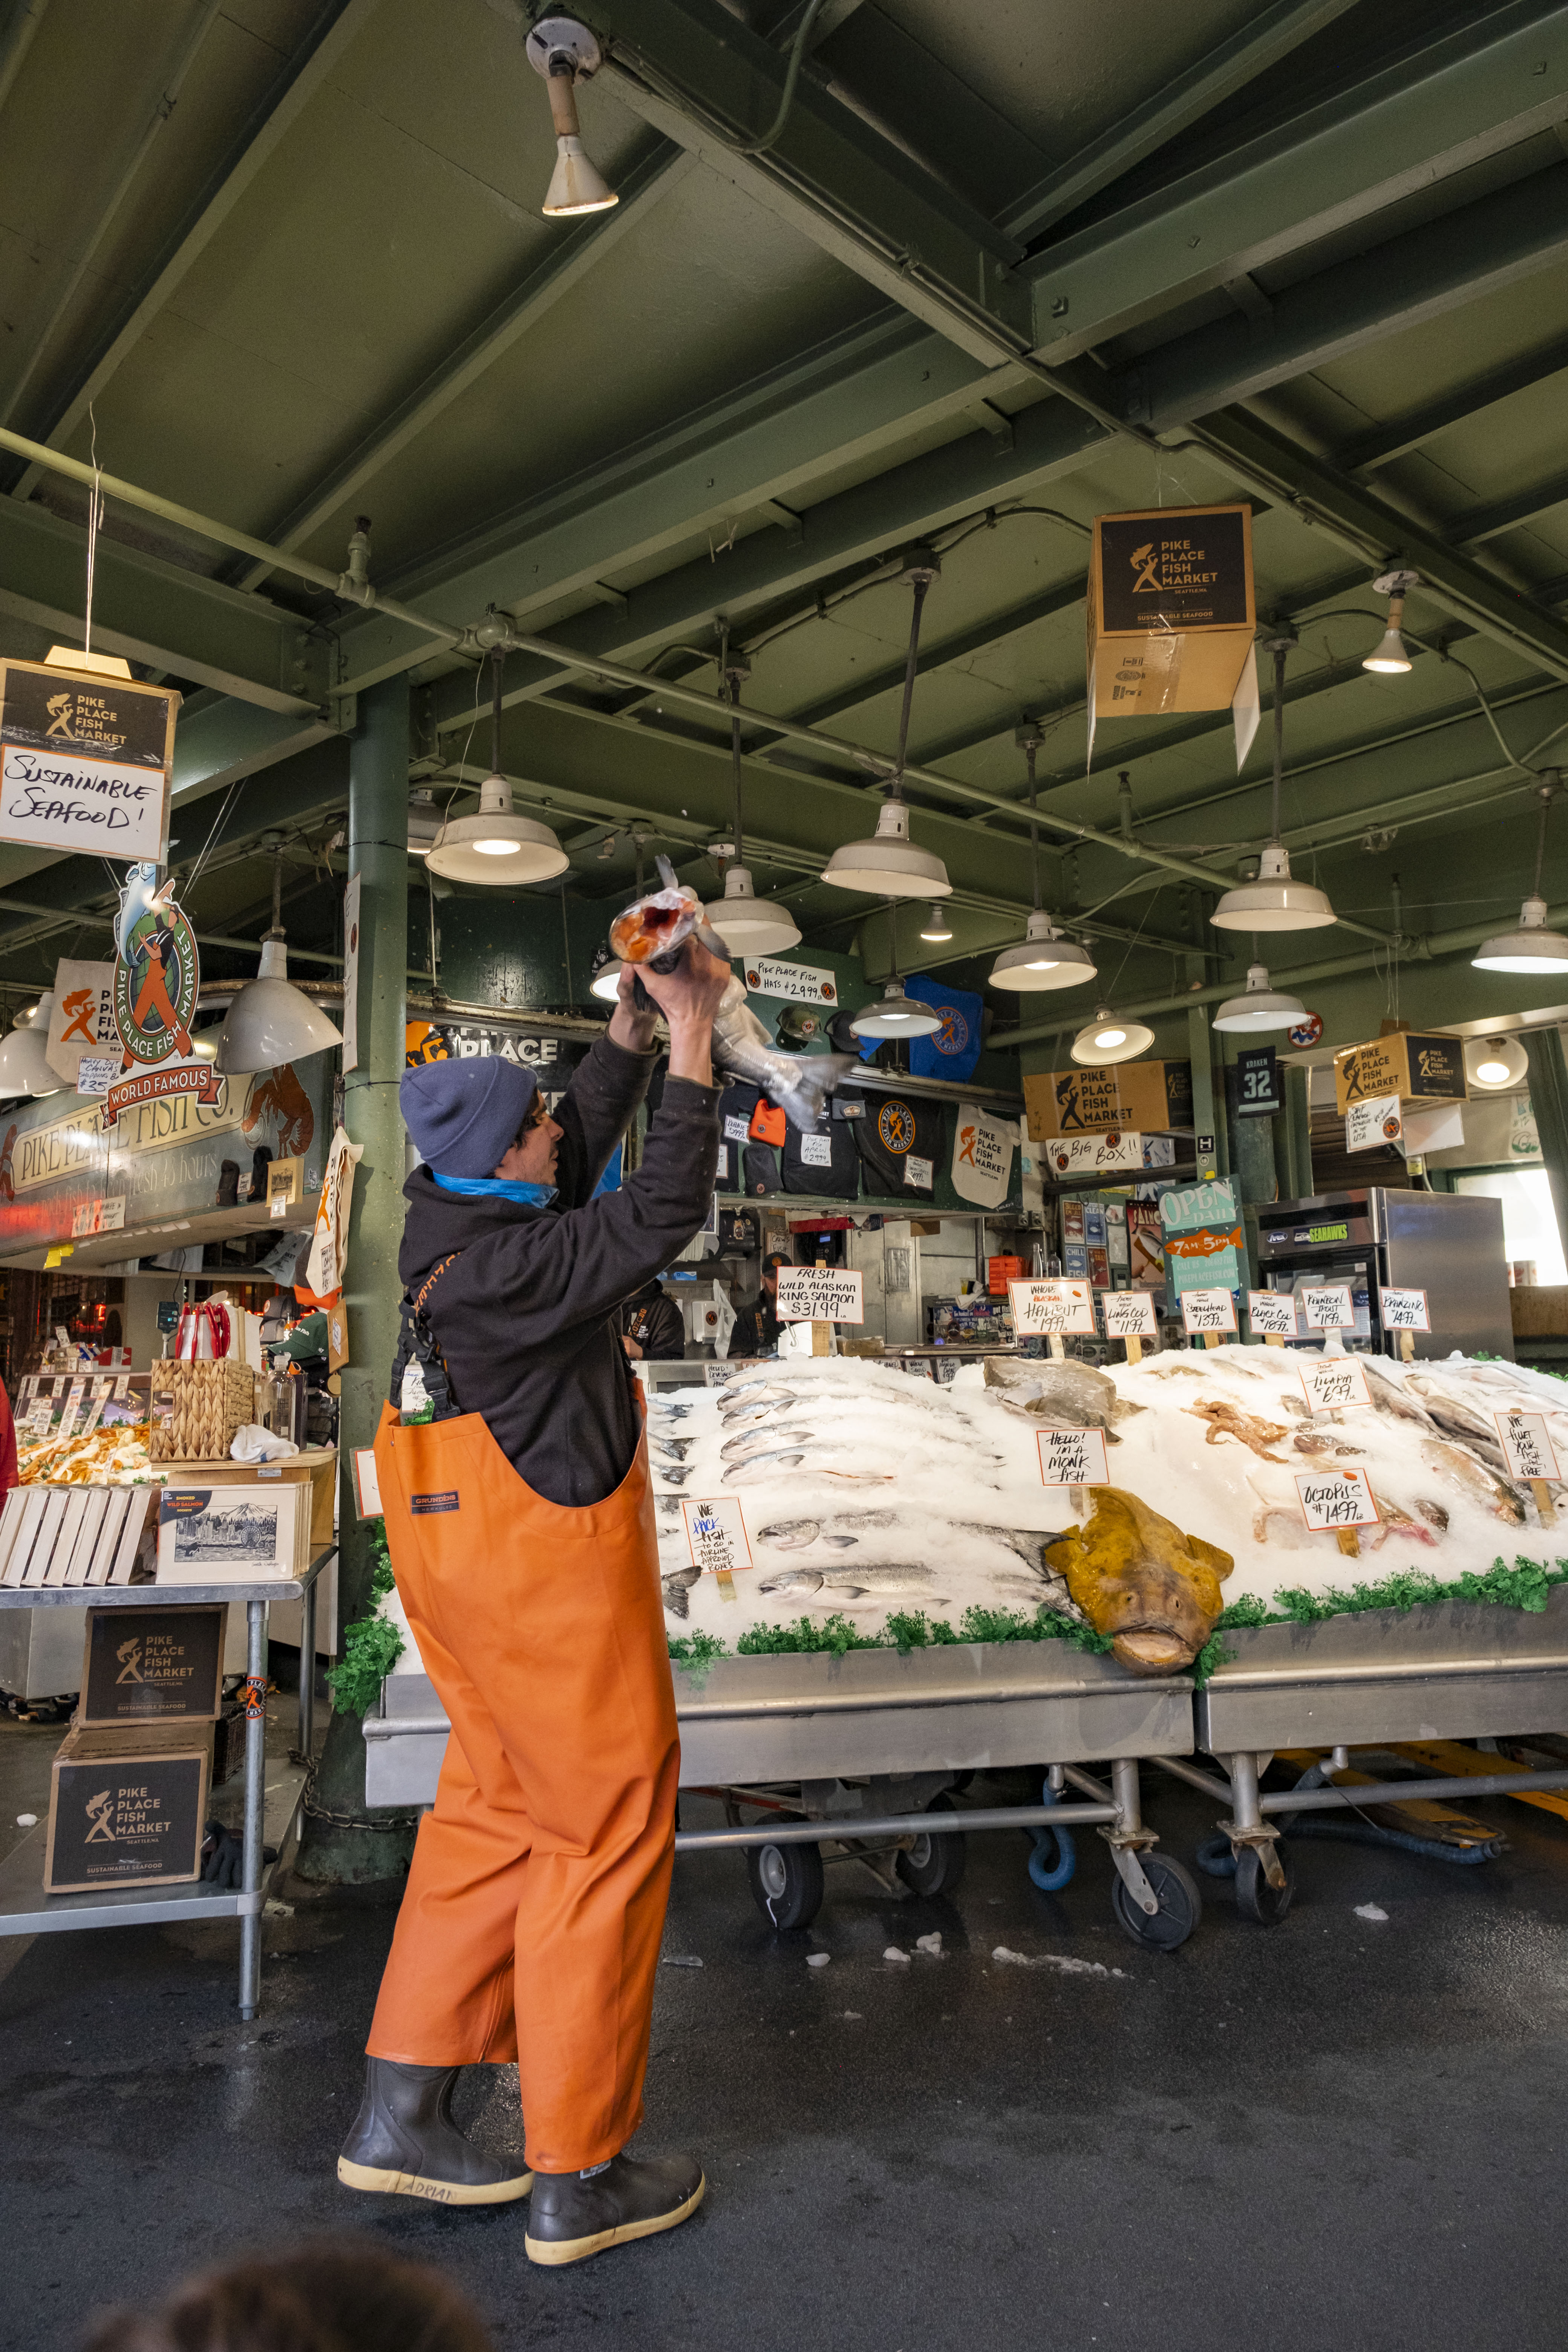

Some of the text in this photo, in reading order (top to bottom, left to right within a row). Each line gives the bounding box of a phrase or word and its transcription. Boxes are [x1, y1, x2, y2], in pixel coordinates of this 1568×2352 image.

[1161, 540, 1191, 550] PIKE
[1162, 550, 1205, 562] PLACE
[1162, 563, 1191, 574] FISH
[1163, 572, 1218, 585] MARKET
[78, 695, 105, 708] PIKE
[77, 706, 117, 721] PLACE
[76, 717, 103, 730] FISH
[75, 729, 127, 744] MARKET
[179, 930, 194, 1018] MARKET
[758, 962, 816, 982] PIKE PLACE FISH
[764, 979, 781, 988] HATS
[118, 969, 182, 1057] PIKE PLACE FISH
[1361, 1048, 1380, 1060] PIKE
[1246, 1058, 1268, 1069] KRAKEN
[1362, 1056, 1390, 1070] PLACE
[1080, 1070, 1106, 1083] PIKE
[1363, 1069, 1381, 1081] FISH
[111, 1070, 207, 1106] WORLD FAMOUS
[1244, 1070, 1272, 1098] 32
[1364, 1075, 1399, 1091] MARKET
[1083, 1098, 1108, 1110] FISH
[883, 1106, 911, 1124] PIKE PLACE
[1084, 1108, 1133, 1122] MARKET
[21, 1129, 60, 1181] PIKE
[136, 1095, 188, 1143] FISH
[883, 1129, 911, 1148] FISH MARKET
[979, 1128, 995, 1141] PIKE
[1353, 1132, 1366, 1142] USA
[978, 1138, 1001, 1154] PLACE
[1050, 1140, 1092, 1158] THE BIG
[977, 1147, 992, 1160] FISH
[179, 1152, 217, 1183] hours
[975, 1156, 1006, 1175] MARKET
[1159, 1178, 1233, 1226] OPEN
[1133, 1207, 1161, 1225] SALMO
[1193, 1206, 1239, 1223] DAILY
[1309, 1224, 1348, 1243] SEAHAWKS
[773, 1244, 789, 1253] FISH
[797, 1268, 835, 1279] FRESH
[779, 1292, 808, 1300] KING
[1031, 1285, 1058, 1295] WHOLE
[1308, 1291, 1344, 1305] RAINBOW
[1383, 1296, 1424, 1311] BRANZINO
[791, 1301, 839, 1318] $31.99
[1024, 1303, 1087, 1319] HALIBUT
[1130, 1308, 1148, 1318] COD
[1186, 1303, 1227, 1312] STEELHEAD
[1251, 1307, 1292, 1320] BLACK COD
[1311, 1304, 1346, 1312] TROUT
[1305, 1373, 1356, 1388] TILAPIA
[1507, 1415, 1525, 1428] WE
[1046, 1432, 1085, 1446] HELLO!
[1074, 1446, 1088, 1454] A
[1513, 1440, 1539, 1453] YOUR
[1514, 1449, 1544, 1460] FISH
[1048, 1454, 1091, 1469] MONK
[416, 1494, 456, 1504] GRUNDÉNS
[1303, 1482, 1363, 1504] OCTOPUS
[697, 1502, 714, 1518] WE
[693, 1517, 724, 1534] PACK
[694, 1528, 732, 1542] FISH
[698, 1547, 729, 1557] AIRLINE
[701, 1553, 734, 1564] APPROVED
[707, 1561, 733, 1572] BOXES
[146, 1636, 173, 1645] PIKE
[145, 1646, 185, 1656] PLACE
[145, 1658, 171, 1667] FISH
[144, 1667, 194, 1678] MARKET
[118, 1787, 148, 1798] PIKE
[118, 1799, 161, 1810] PLACE
[117, 1812, 146, 1823] FISH
[116, 1822, 171, 1835] MARKET
[87, 1865, 130, 1873] SUSTAINABLE
[402, 2182, 457, 2201] ADRIAN
